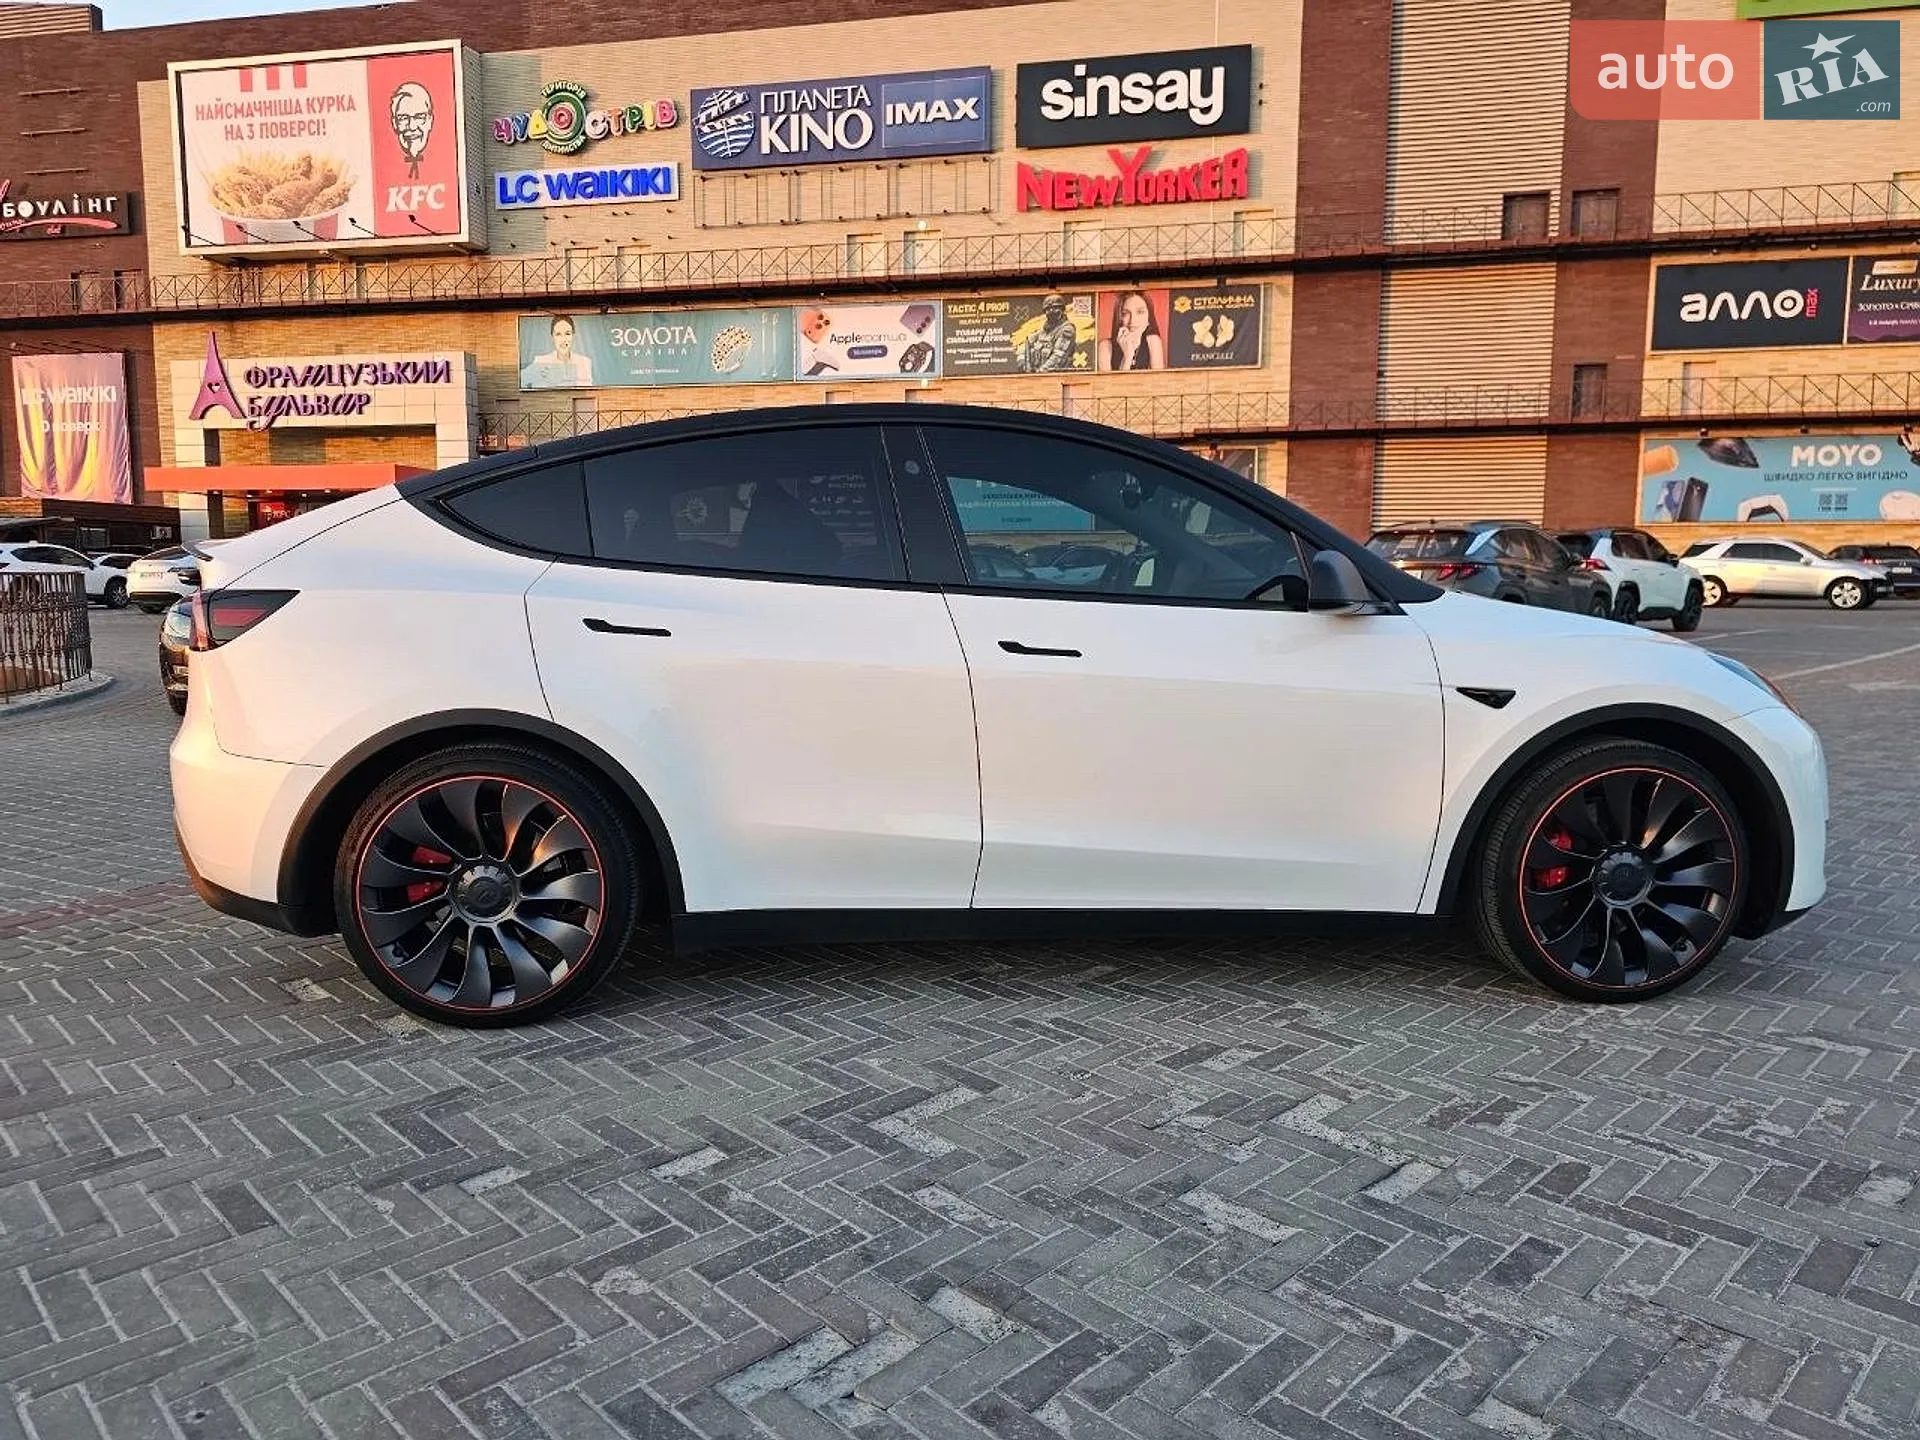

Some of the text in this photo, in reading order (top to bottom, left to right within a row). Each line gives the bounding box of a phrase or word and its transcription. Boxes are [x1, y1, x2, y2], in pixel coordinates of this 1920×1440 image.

[541, 80, 587, 100] ТЕРИТОРІЯ
[1040, 64, 1225, 125] sinsay
[195, 94, 356, 121] НАЙСМАЧНІША КУРКА
[885, 97, 979, 125] IMAX
[224, 119, 327, 141] НА 3 ПОВЕРСІ!
[761, 107, 873, 155] KINO
[386, 183, 446, 213] KFC
[500, 174, 540, 204] LC
[978, 301, 985, 312] 4
[610, 325, 697, 346] ЗОЛОТА
[244, 359, 450, 388] ФРАНЦУЗЬКИЙ
[246, 393, 371, 431] БУЛЬВАР
[1790, 444, 1882, 468] MOYO
[1763, 470, 1908, 482] ШВИДКО ЛЕГКО ВИГІДНО
